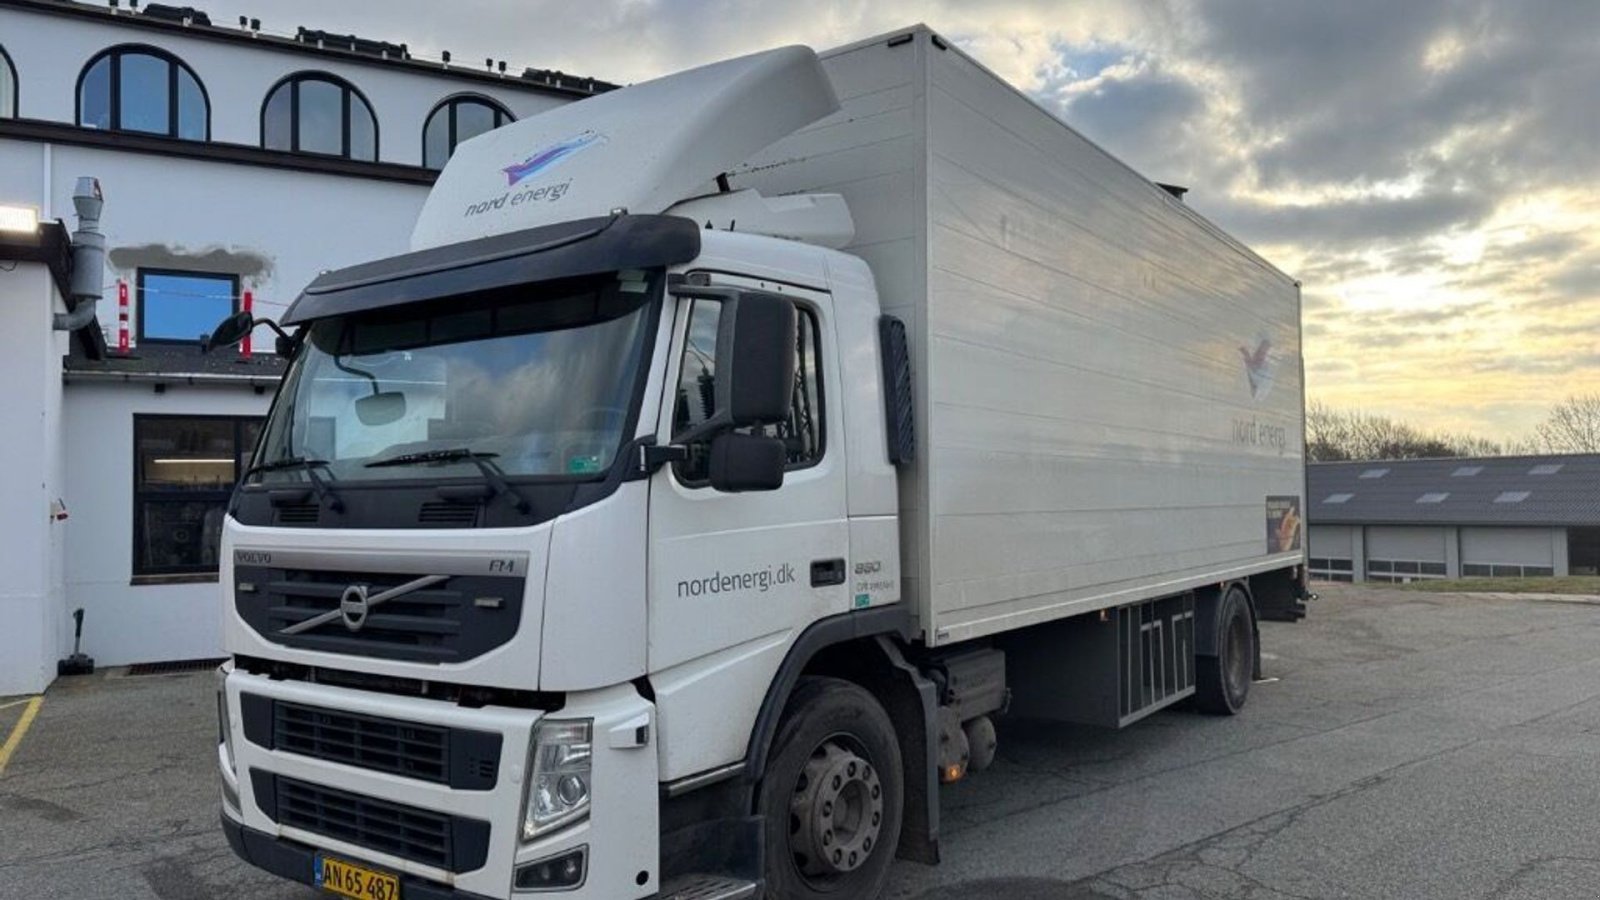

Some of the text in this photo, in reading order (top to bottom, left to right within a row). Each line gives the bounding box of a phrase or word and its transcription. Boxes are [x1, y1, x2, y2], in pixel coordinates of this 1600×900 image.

[464, 177, 574, 217] nord energi
[234, 550, 272, 563] VOLVO
[489, 559, 514, 572] FM
[677, 563, 795, 598] nordenergi.dk
[324, 863, 395, 900] AN 65 487
